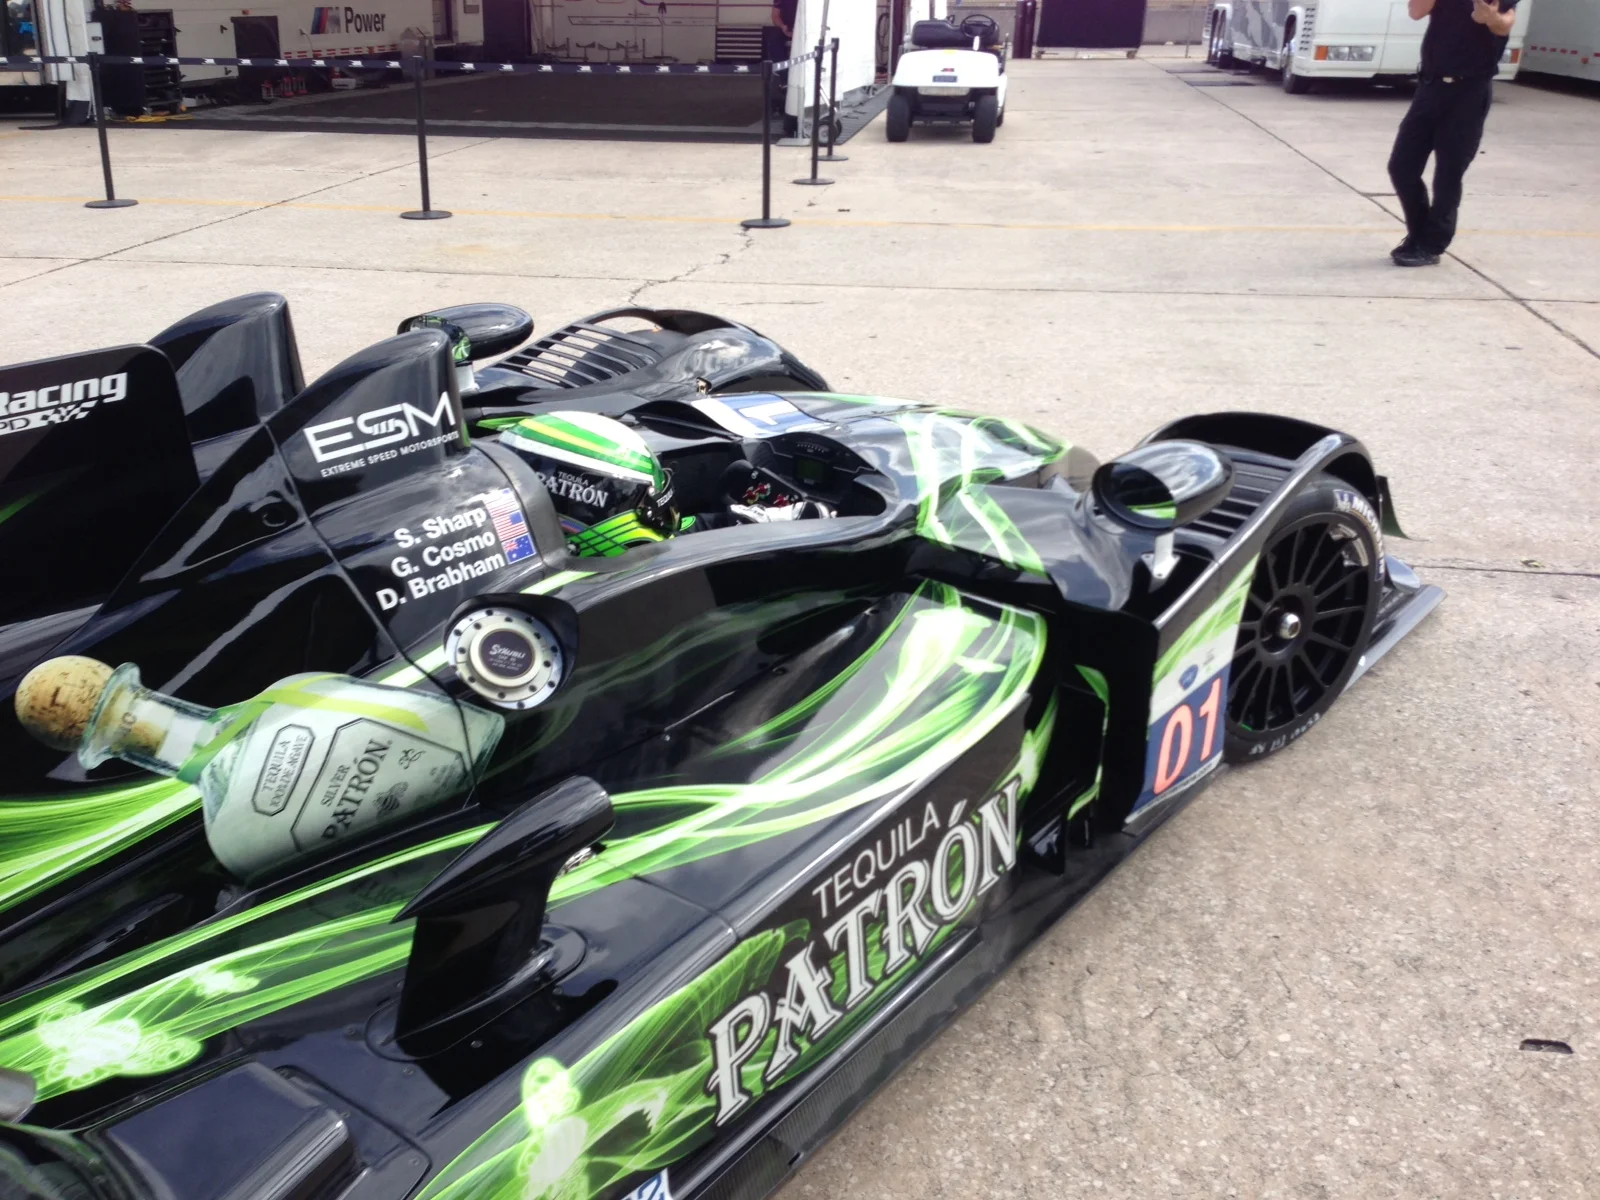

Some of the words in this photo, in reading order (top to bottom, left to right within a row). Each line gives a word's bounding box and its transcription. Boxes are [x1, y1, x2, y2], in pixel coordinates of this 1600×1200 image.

[344, 6, 386, 34] Power
[303, 391, 456, 463] ESM
[320, 458, 366, 478] EXTREME
[368, 449, 398, 465] SPEED
[400, 430, 460, 456] MOTORSPORTS
[557, 471, 589, 486] TEQUILA
[393, 527, 422, 549] S.
[422, 507, 487, 539] Sharp
[390, 556, 420, 578] G.
[422, 531, 496, 567] Cosmo
[376, 587, 407, 611] D.
[407, 553, 505, 600] Brabham
[1153, 677, 1221, 795] 01
[261, 740, 292, 793] TEQUILA
[320, 764, 351, 807] SILVER
[812, 801, 940, 918] TEQUILA
[707, 776, 1021, 1127] PATRÓN
